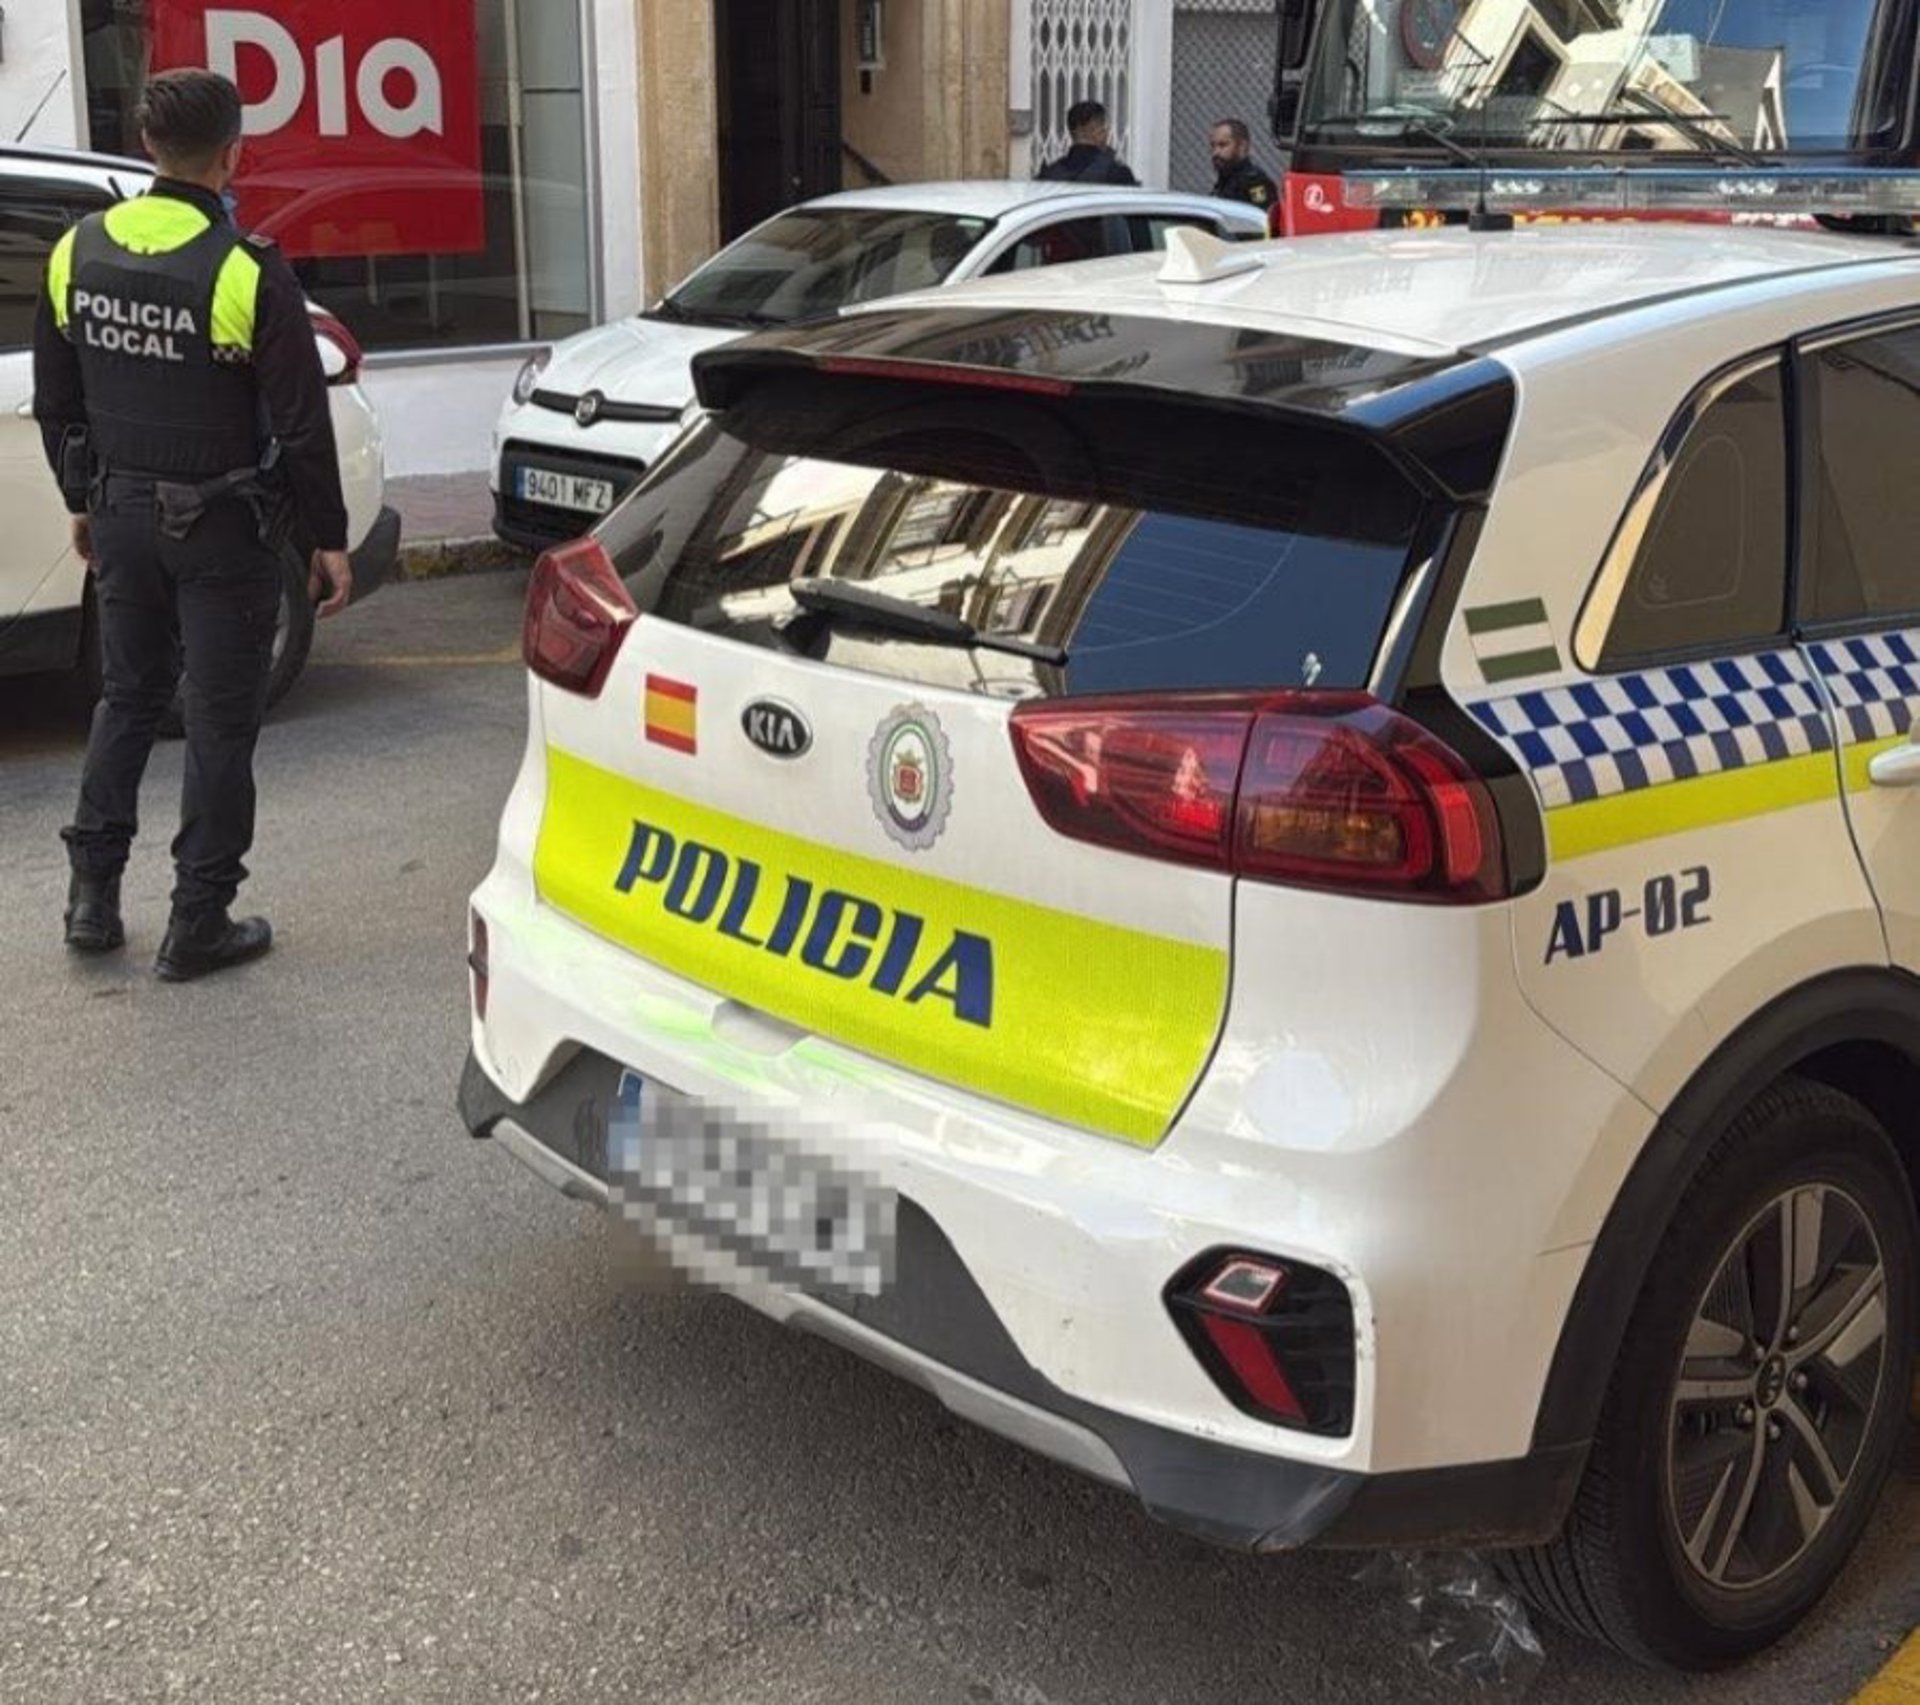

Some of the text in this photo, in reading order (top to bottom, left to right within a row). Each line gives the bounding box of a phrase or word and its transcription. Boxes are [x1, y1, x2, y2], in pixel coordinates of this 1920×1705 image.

[73, 290, 197, 335] POLICIA
[84, 321, 184, 361] LOCAL
[528, 471, 567, 502] 9401
[750, 708, 798, 751] KIA
[614, 819, 994, 1029] POLICIA
[1543, 865, 1712, 965] AP-02
